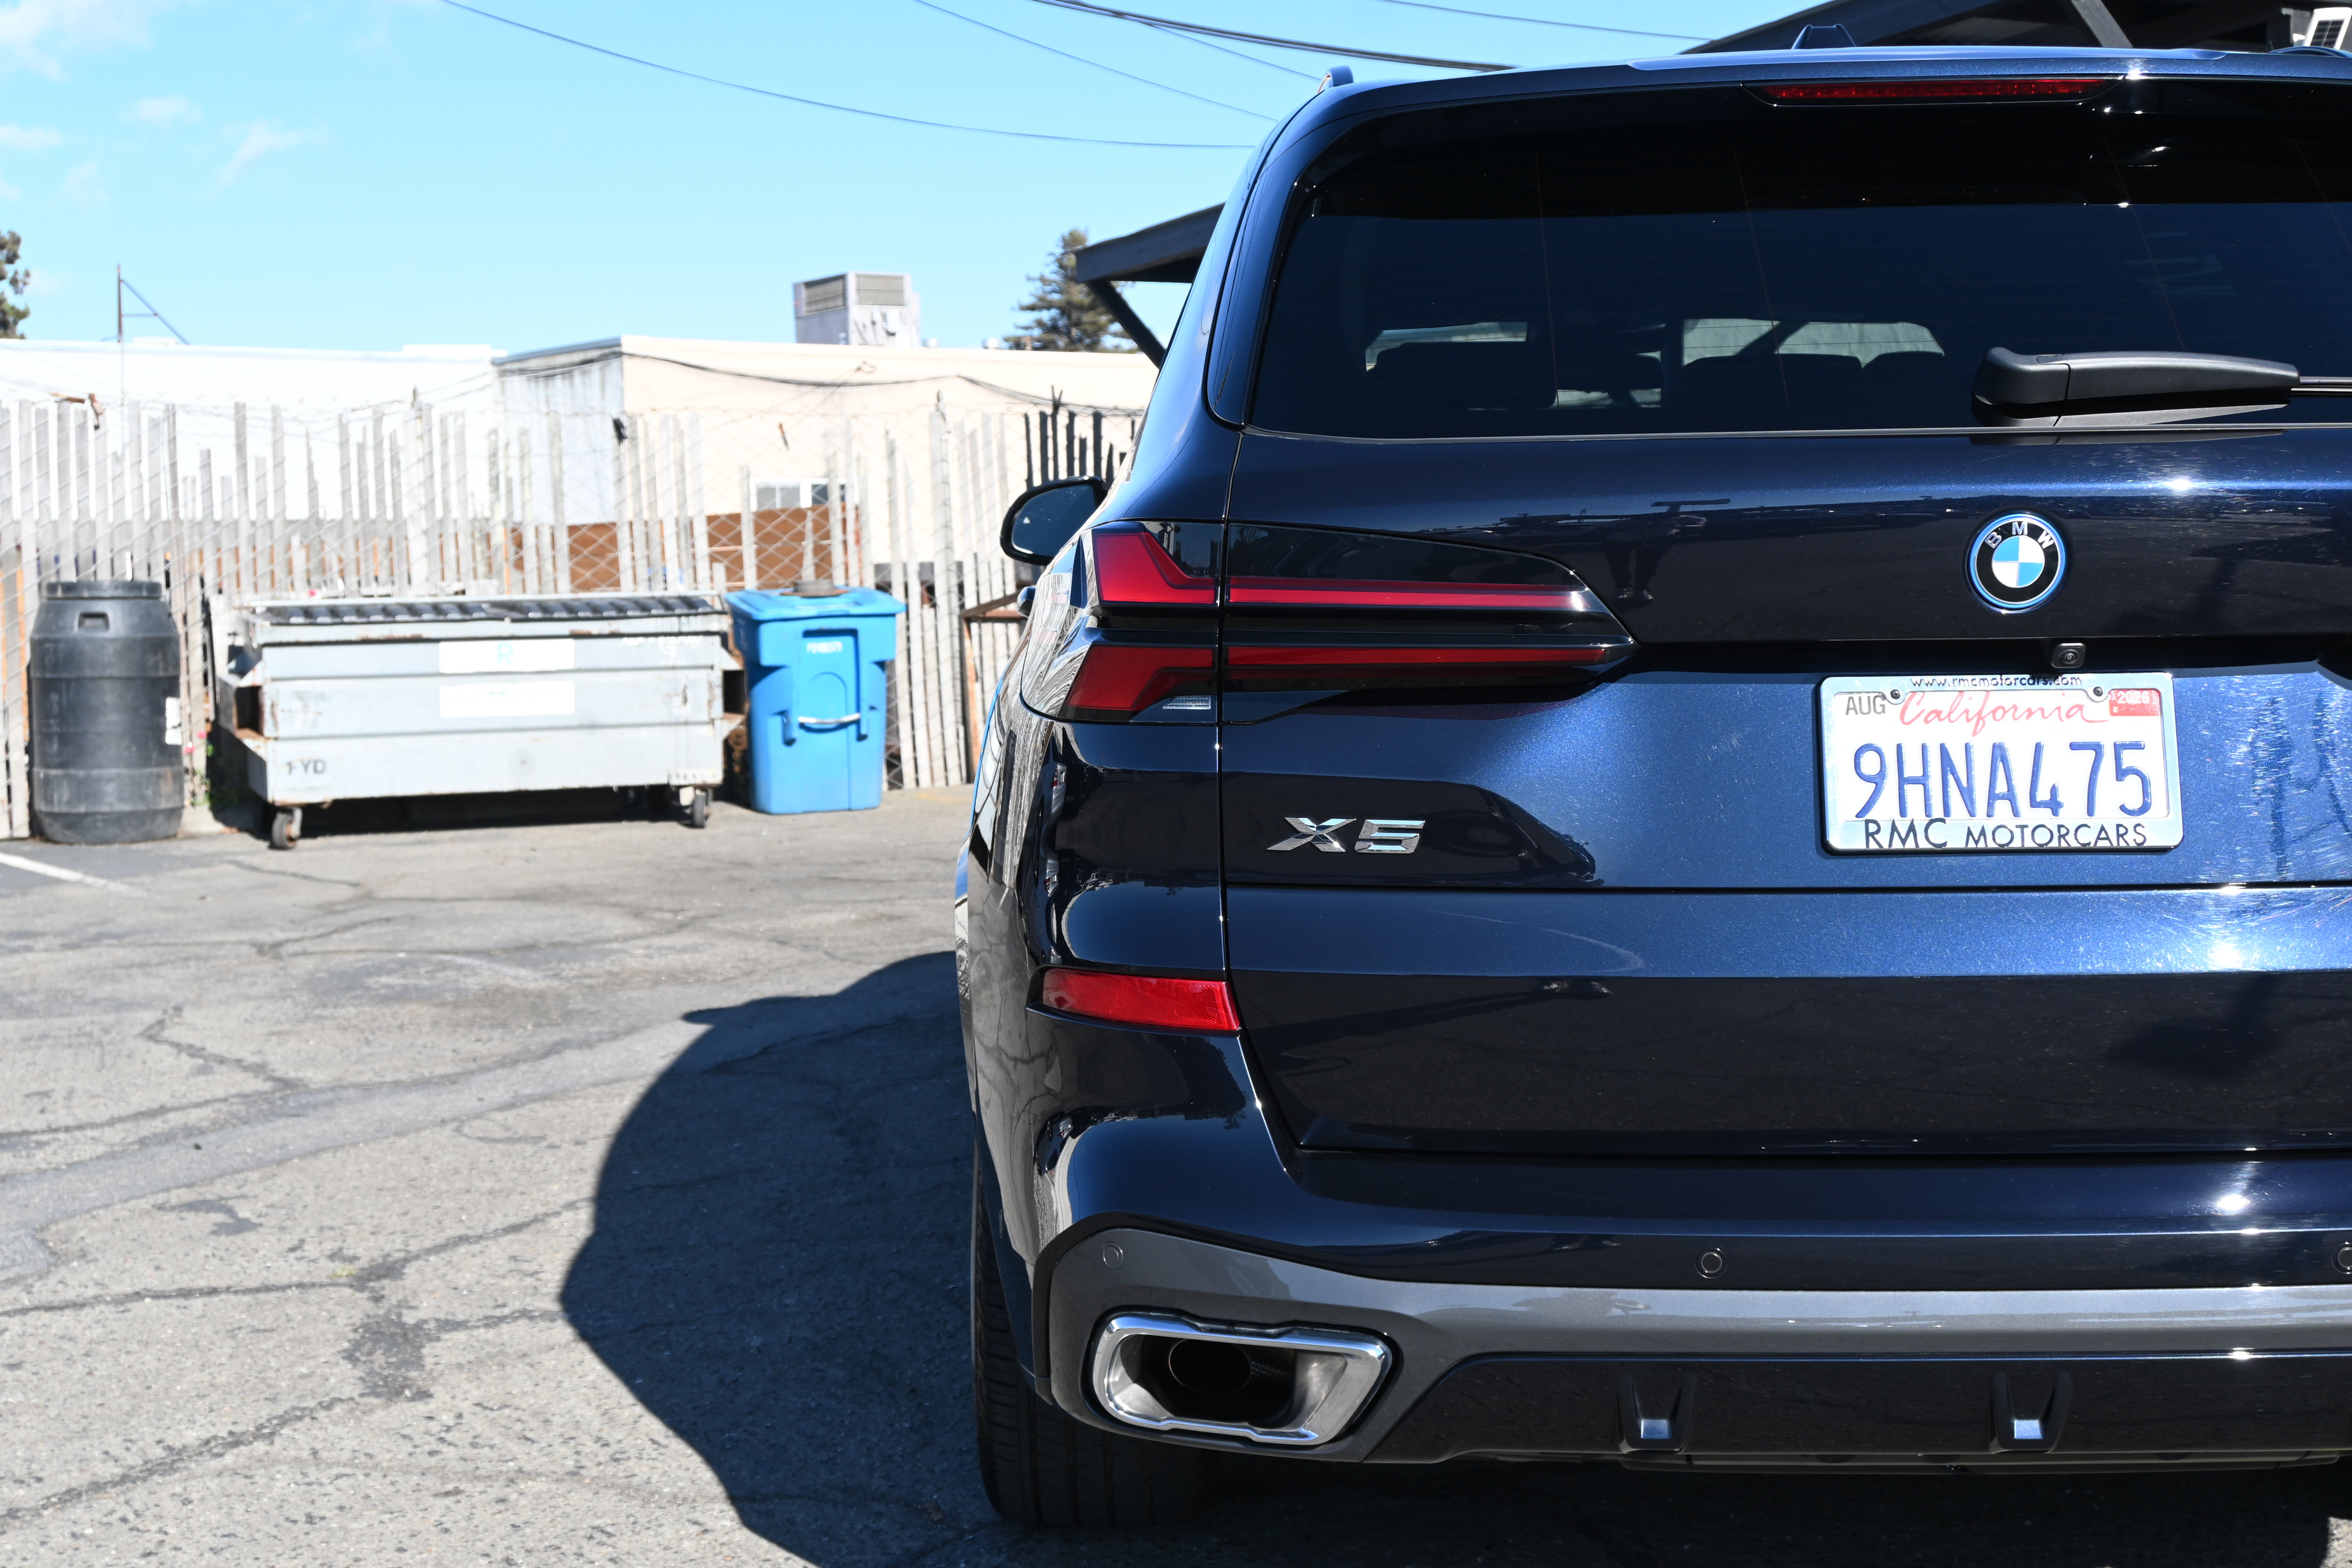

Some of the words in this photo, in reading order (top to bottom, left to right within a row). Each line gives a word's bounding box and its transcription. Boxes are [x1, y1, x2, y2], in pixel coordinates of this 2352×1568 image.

[1984, 521, 2054, 549] BMW
[1911, 675, 2082, 686] www.rmcmotorcars.com
[1845, 695, 1886, 715] AUG
[2117, 690, 2150, 704] 2026
[1900, 691, 2109, 737] California
[1854, 741, 2152, 819] 9HNA475
[1266, 817, 1426, 854] X5
[1865, 818, 1947, 848] RMC
[1964, 823, 2147, 848] MOTORCARS
